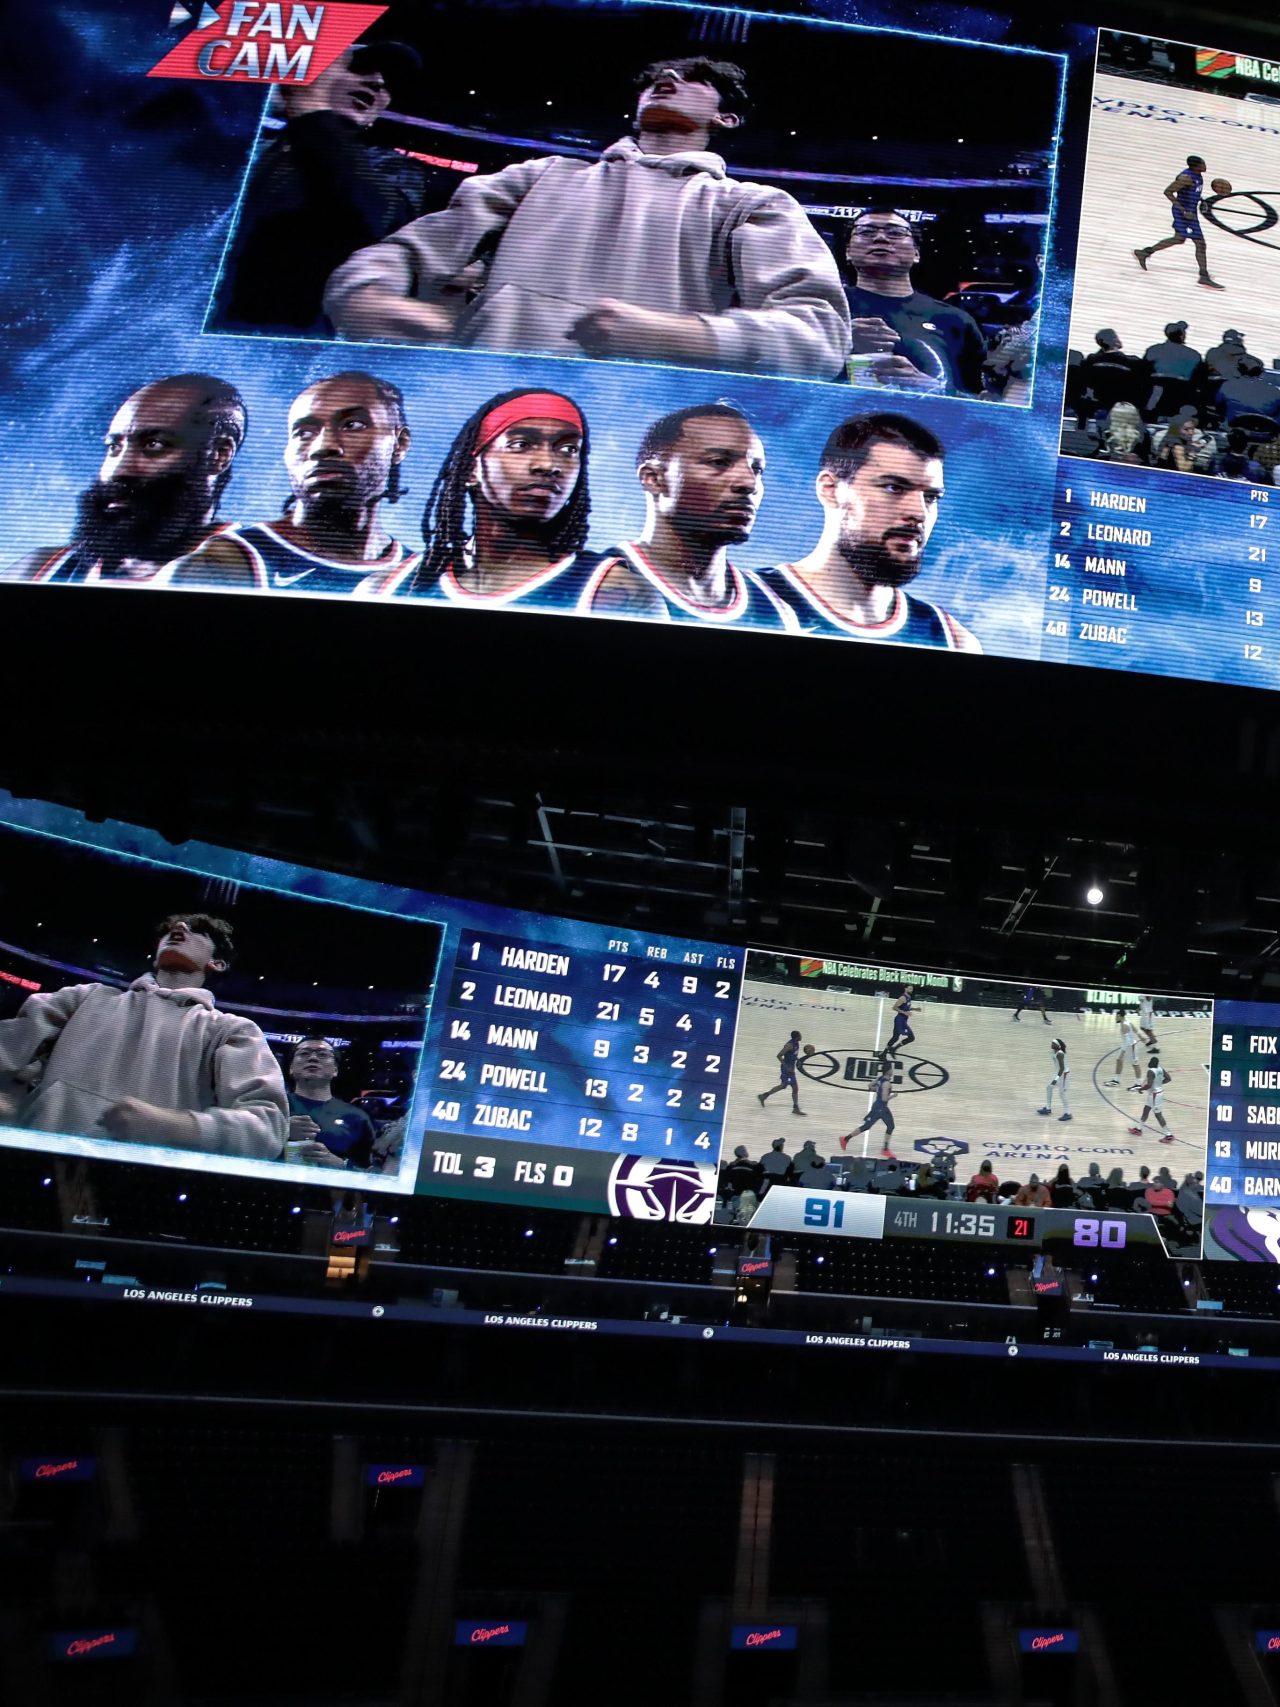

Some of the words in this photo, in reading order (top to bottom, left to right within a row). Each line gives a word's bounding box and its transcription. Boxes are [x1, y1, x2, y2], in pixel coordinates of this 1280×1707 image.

[226, 0, 324, 40] FAN
[198, 40, 314, 81] CAM
[1235, 56, 1261, 79] NBA
[1065, 489, 1072, 503] 1
[1090, 491, 1146, 513] HARDEN
[1250, 490, 1269, 502] PTS
[1060, 522, 1071, 536] 2
[1088, 524, 1151, 547] LEONARD
[1054, 554, 1071, 569] 14
[1085, 556, 1126, 576] MANN
[1049, 587, 1070, 601] 24
[1082, 589, 1138, 611] POWELL
[1046, 621, 1067, 636] 40
[1079, 623, 1127, 644] ZUBAC
[471, 942, 480, 960] 1
[501, 947, 570, 976] HARDEN
[608, 940, 628, 953] PTS
[647, 946, 667, 959] REB
[684, 952, 704, 964] AST
[717, 957, 735, 970] FLS
[460, 982, 476, 1000] 2
[494, 985, 572, 1016] LEONARD
[450, 1020, 471, 1040] 14
[487, 1025, 538, 1050] MANN
[1222, 1035, 1233, 1051] 5
[1250, 1036, 1277, 1054] FOX
[439, 1060, 466, 1080] 24
[480, 1064, 548, 1093] POWELL
[1220, 1071, 1231, 1087] 9
[432, 1101, 460, 1121] 40
[473, 1104, 532, 1130] ZUBAC
[1216, 1106, 1232, 1122] 10
[1215, 1141, 1231, 1158] 13
[433, 1151, 463, 1175] TOL
[473, 1156, 496, 1178] 3
[514, 1161, 546, 1185] FLS
[1210, 1177, 1231, 1193] 40
[804, 1198, 843, 1228] 91
[893, 1211, 918, 1229] 4TH
[932, 1212, 995, 1236] 11:35
[1014, 1219, 1027, 1237] 21
[1073, 1218, 1126, 1248] 80
[124, 1289, 145, 1298] LOS
[147, 1291, 197, 1302] ANGELES
[200, 1295, 253, 1306] CLIPPERS
[485, 1315, 503, 1324] LOS
[505, 1317, 548, 1326] ANGELES
[551, 1320, 597, 1330] CLIPPERS
[825, 1337, 865, 1346] ANGELES
[868, 1339, 910, 1348] CLIPPERS
[35, 1461, 78, 1477] Clippers
[377, 1469, 412, 1483] Clippers
[66, 1633, 115, 1655] Clippers
[471, 1625, 510, 1642] Clippers
[745, 1630, 782, 1646] Clippers
[1031, 1634, 1064, 1649] Clippers
